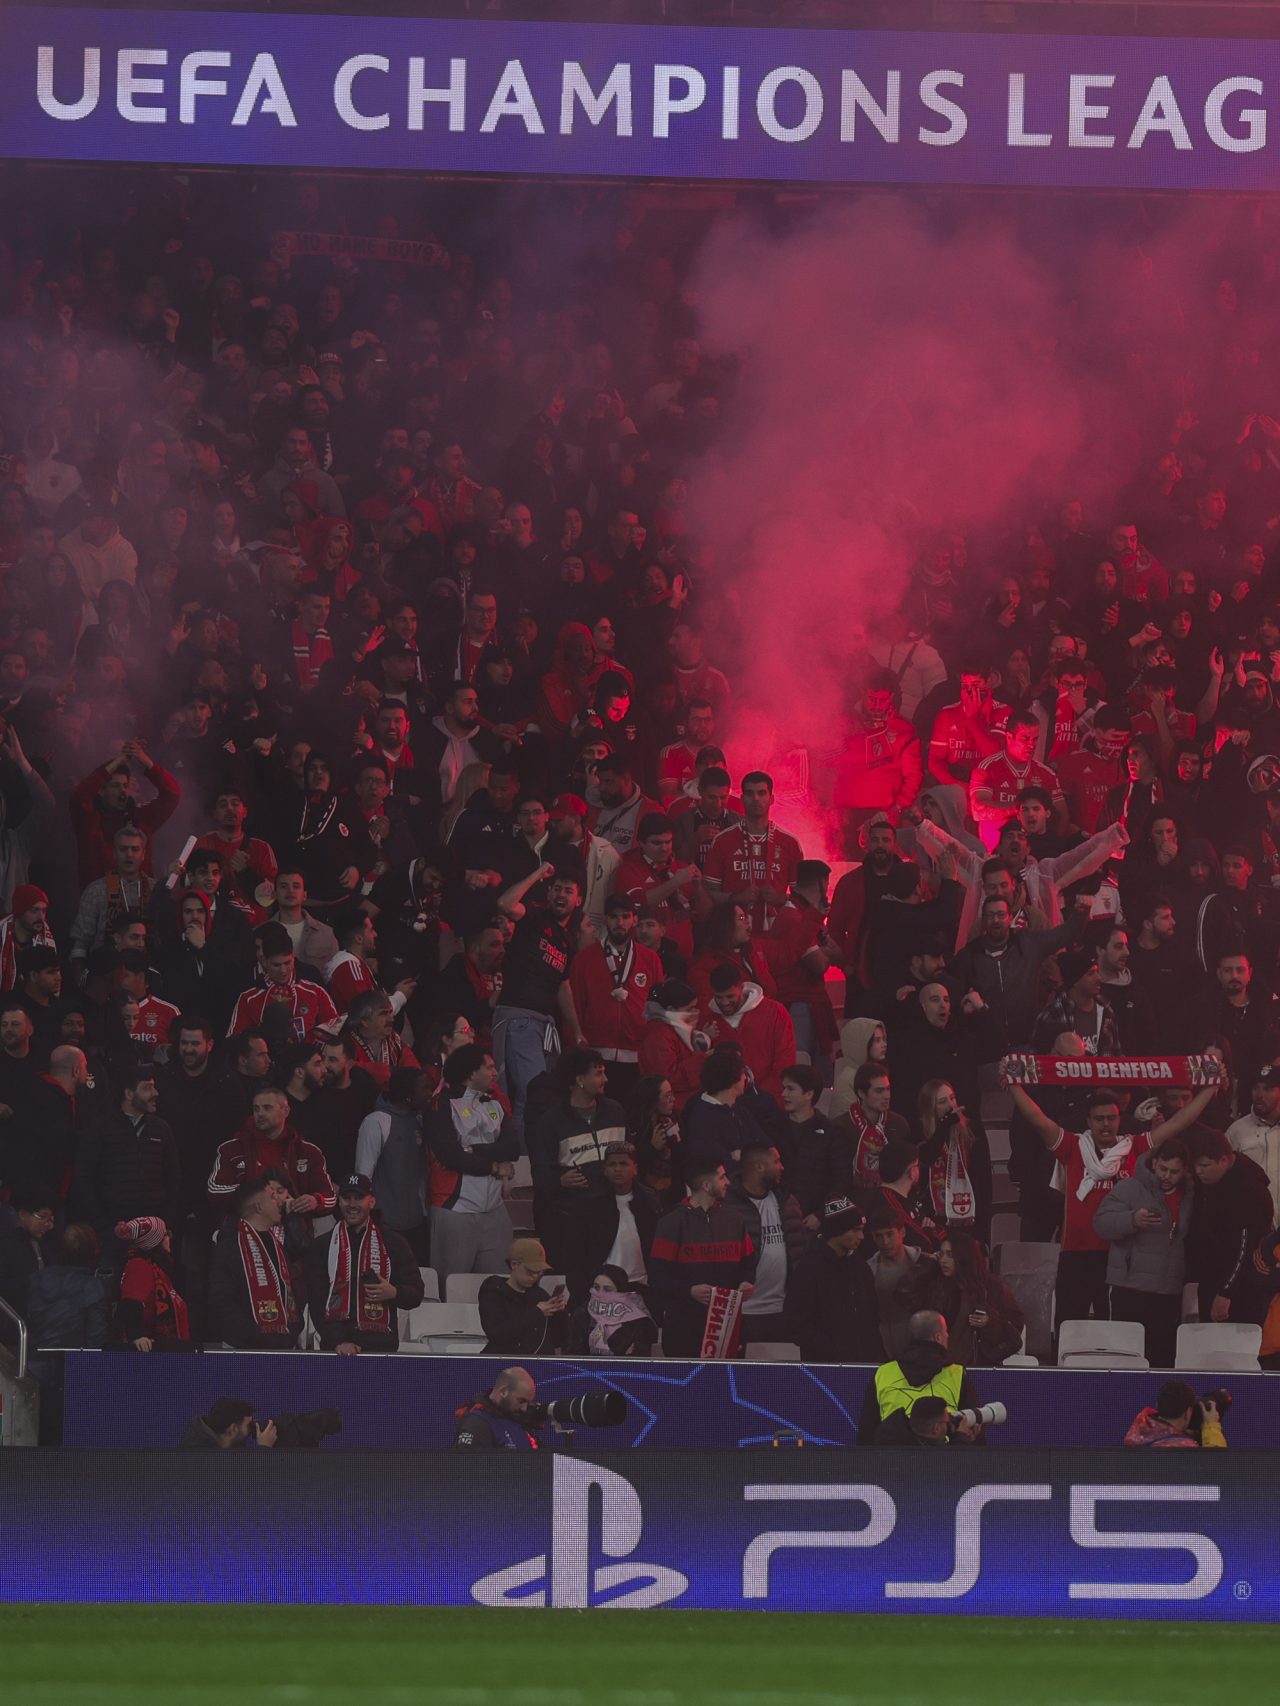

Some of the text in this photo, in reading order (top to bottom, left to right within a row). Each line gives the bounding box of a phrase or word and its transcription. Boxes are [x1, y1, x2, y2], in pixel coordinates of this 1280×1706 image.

[37, 46, 297, 127] UEFA
[334, 54, 968, 147] CHAMPIONS
[1055, 1061, 1173, 1079] SOU BENFICA
[703, 1287, 732, 1359] BENFIC
[742, 1484, 1225, 1600] PS5
